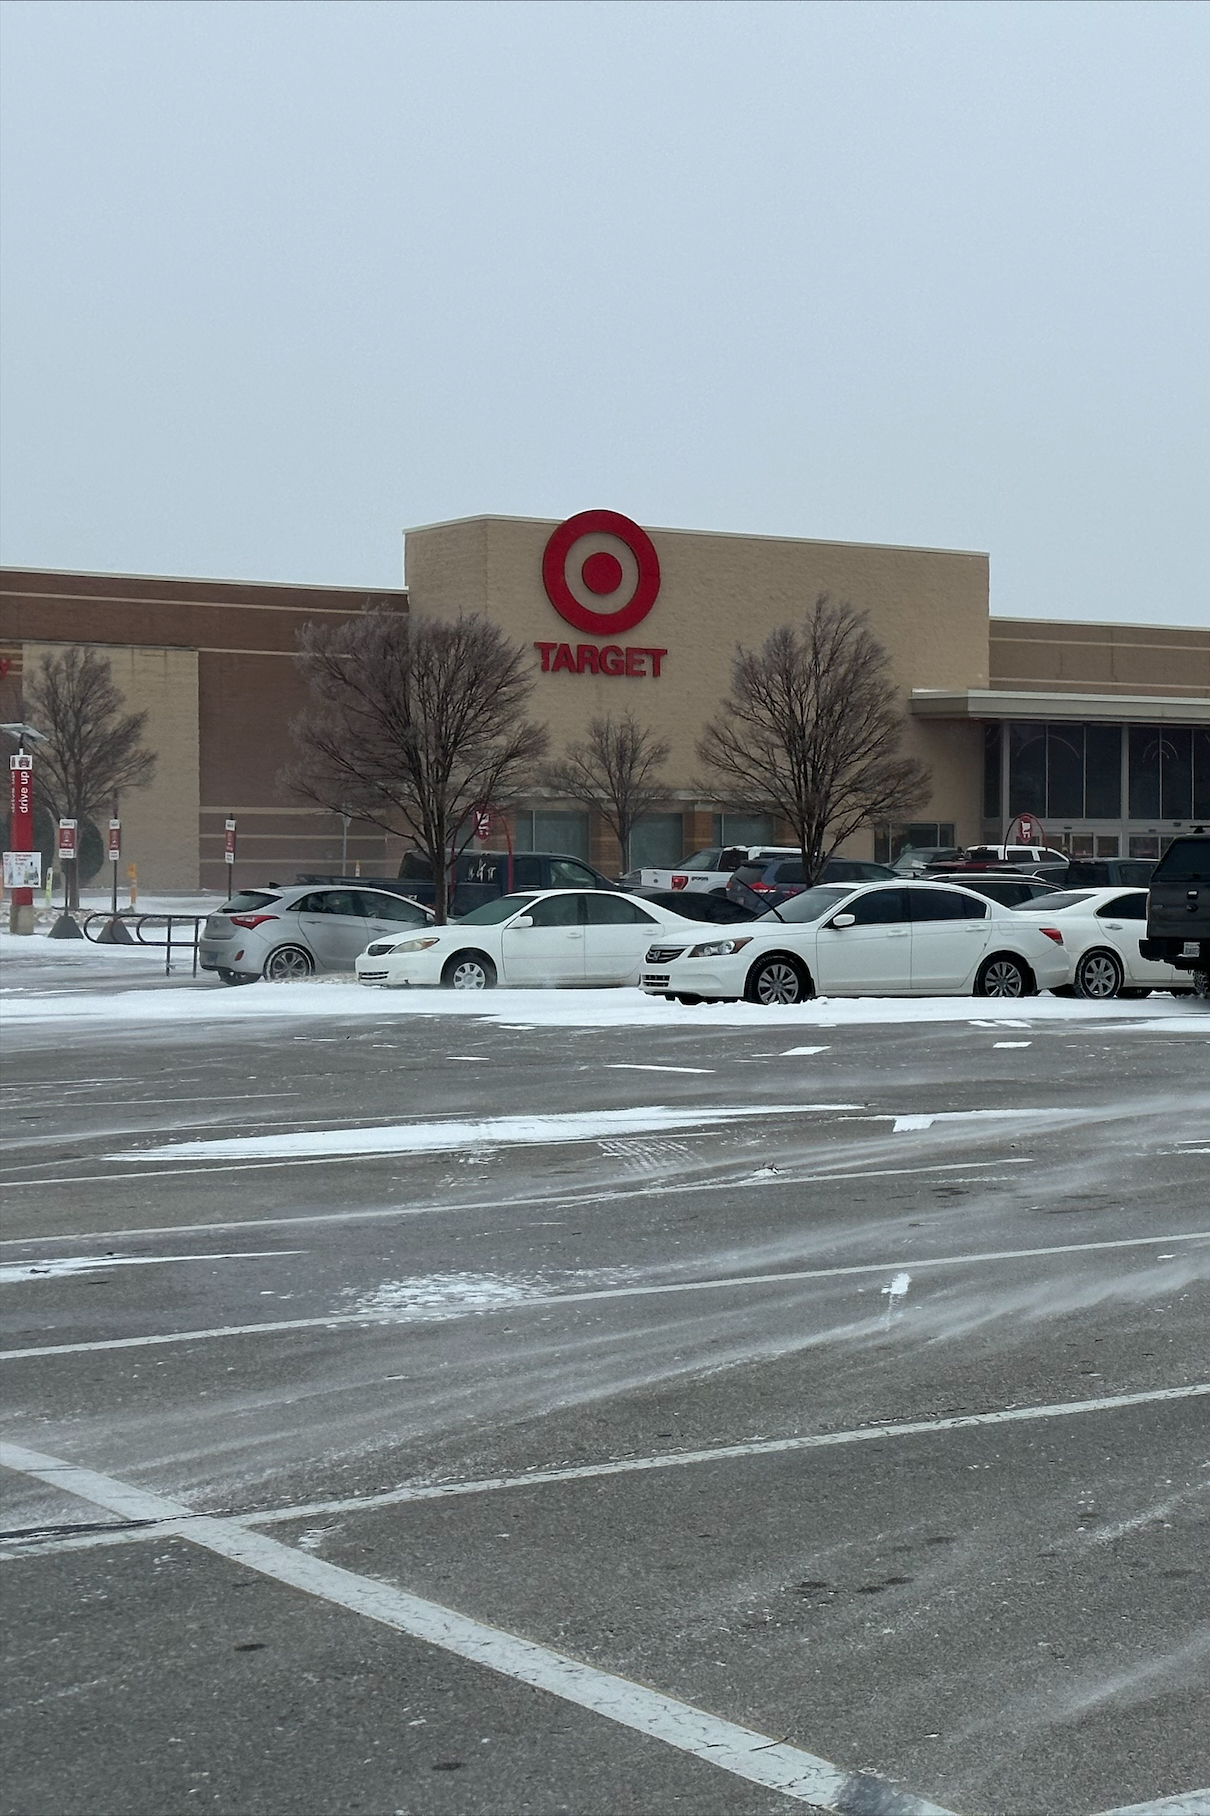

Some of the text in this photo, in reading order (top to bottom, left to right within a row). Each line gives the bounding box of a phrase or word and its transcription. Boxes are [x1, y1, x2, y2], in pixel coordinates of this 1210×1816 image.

[534, 641, 668, 678] TARGET
[19, 770, 30, 814] drive up
